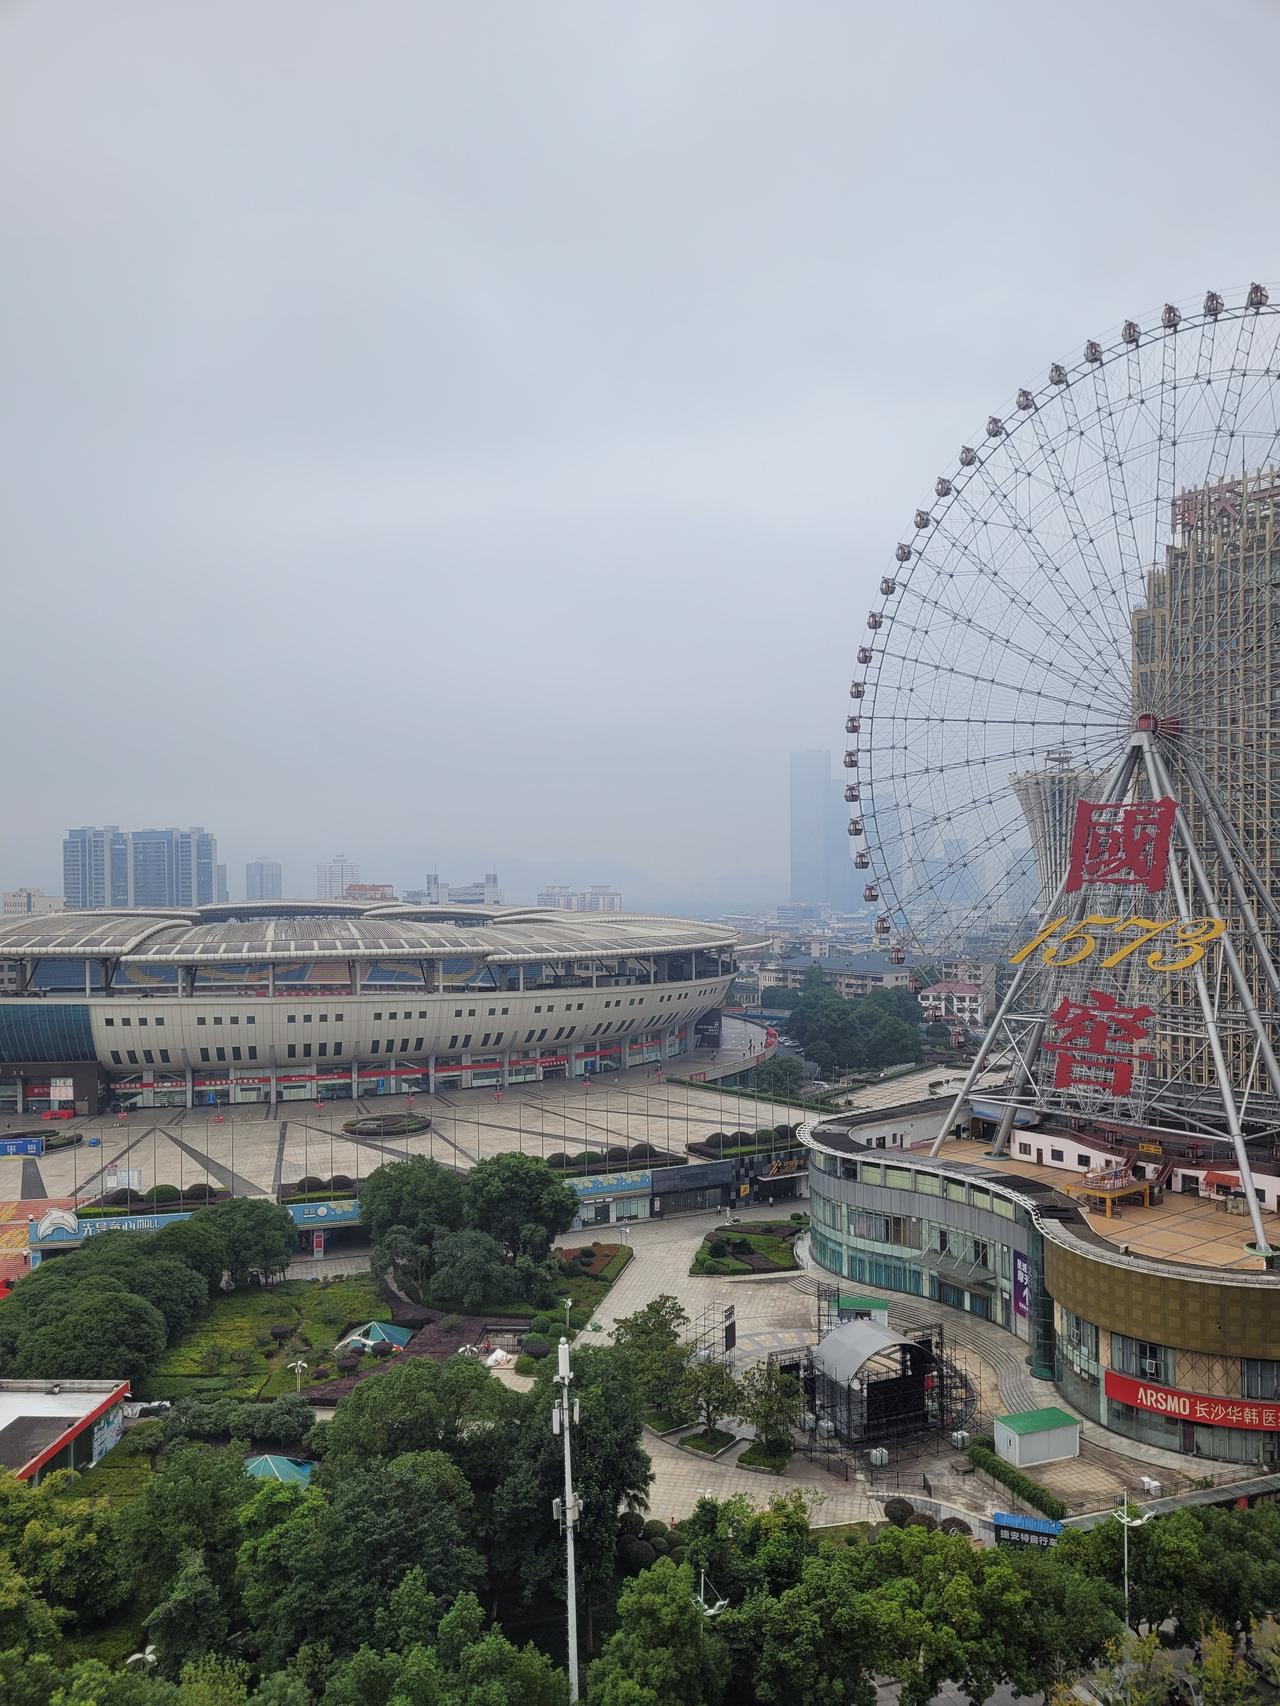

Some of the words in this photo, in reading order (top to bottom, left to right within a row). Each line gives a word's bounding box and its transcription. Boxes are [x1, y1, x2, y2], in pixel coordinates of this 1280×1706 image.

[1008, 915, 1227, 971] 1573
[1041, 989, 1155, 1097] 窖
[137, 1218, 161, 1230] MALL
[1137, 1387, 1190, 1415] ARSMO
[1195, 1400, 1280, 1427] 长沙华韩医
